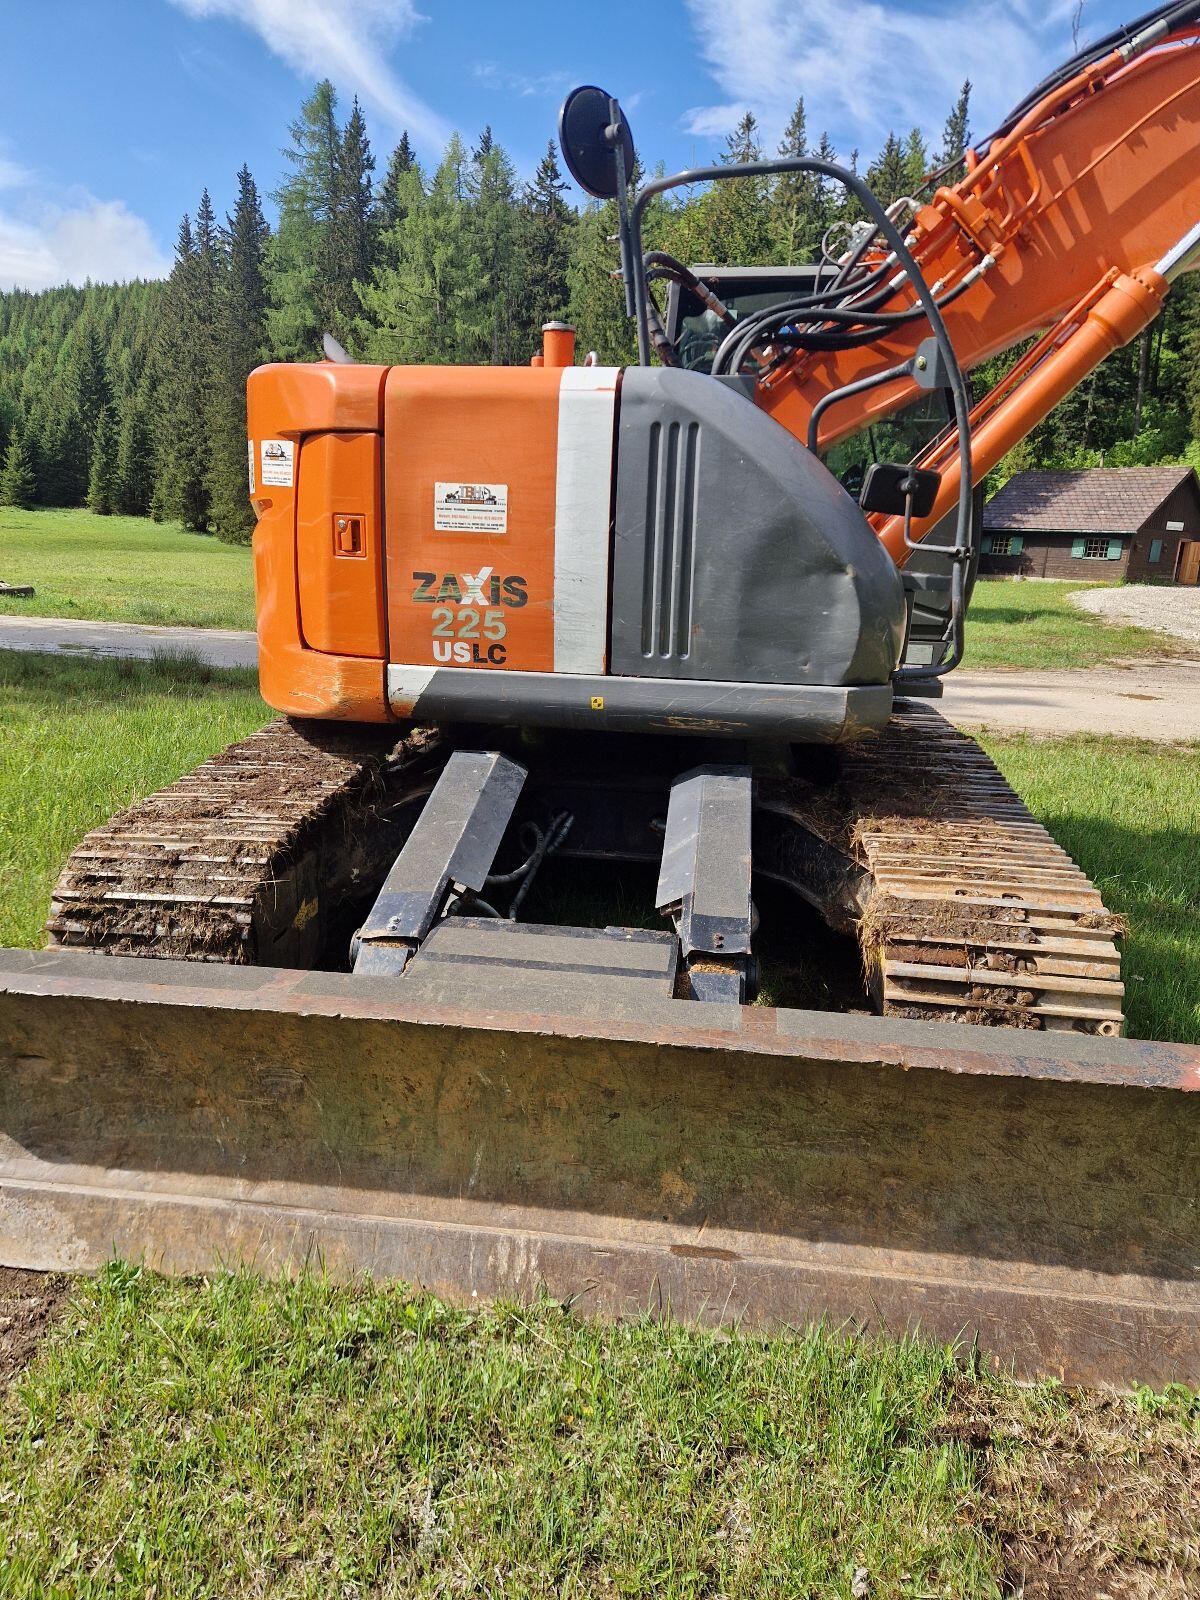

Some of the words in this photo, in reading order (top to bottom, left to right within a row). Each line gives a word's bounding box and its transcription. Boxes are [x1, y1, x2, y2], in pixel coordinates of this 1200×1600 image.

[412, 566, 528, 608] ZAXIS
[431, 607, 507, 640] 225
[432, 640, 507, 665] USLC
